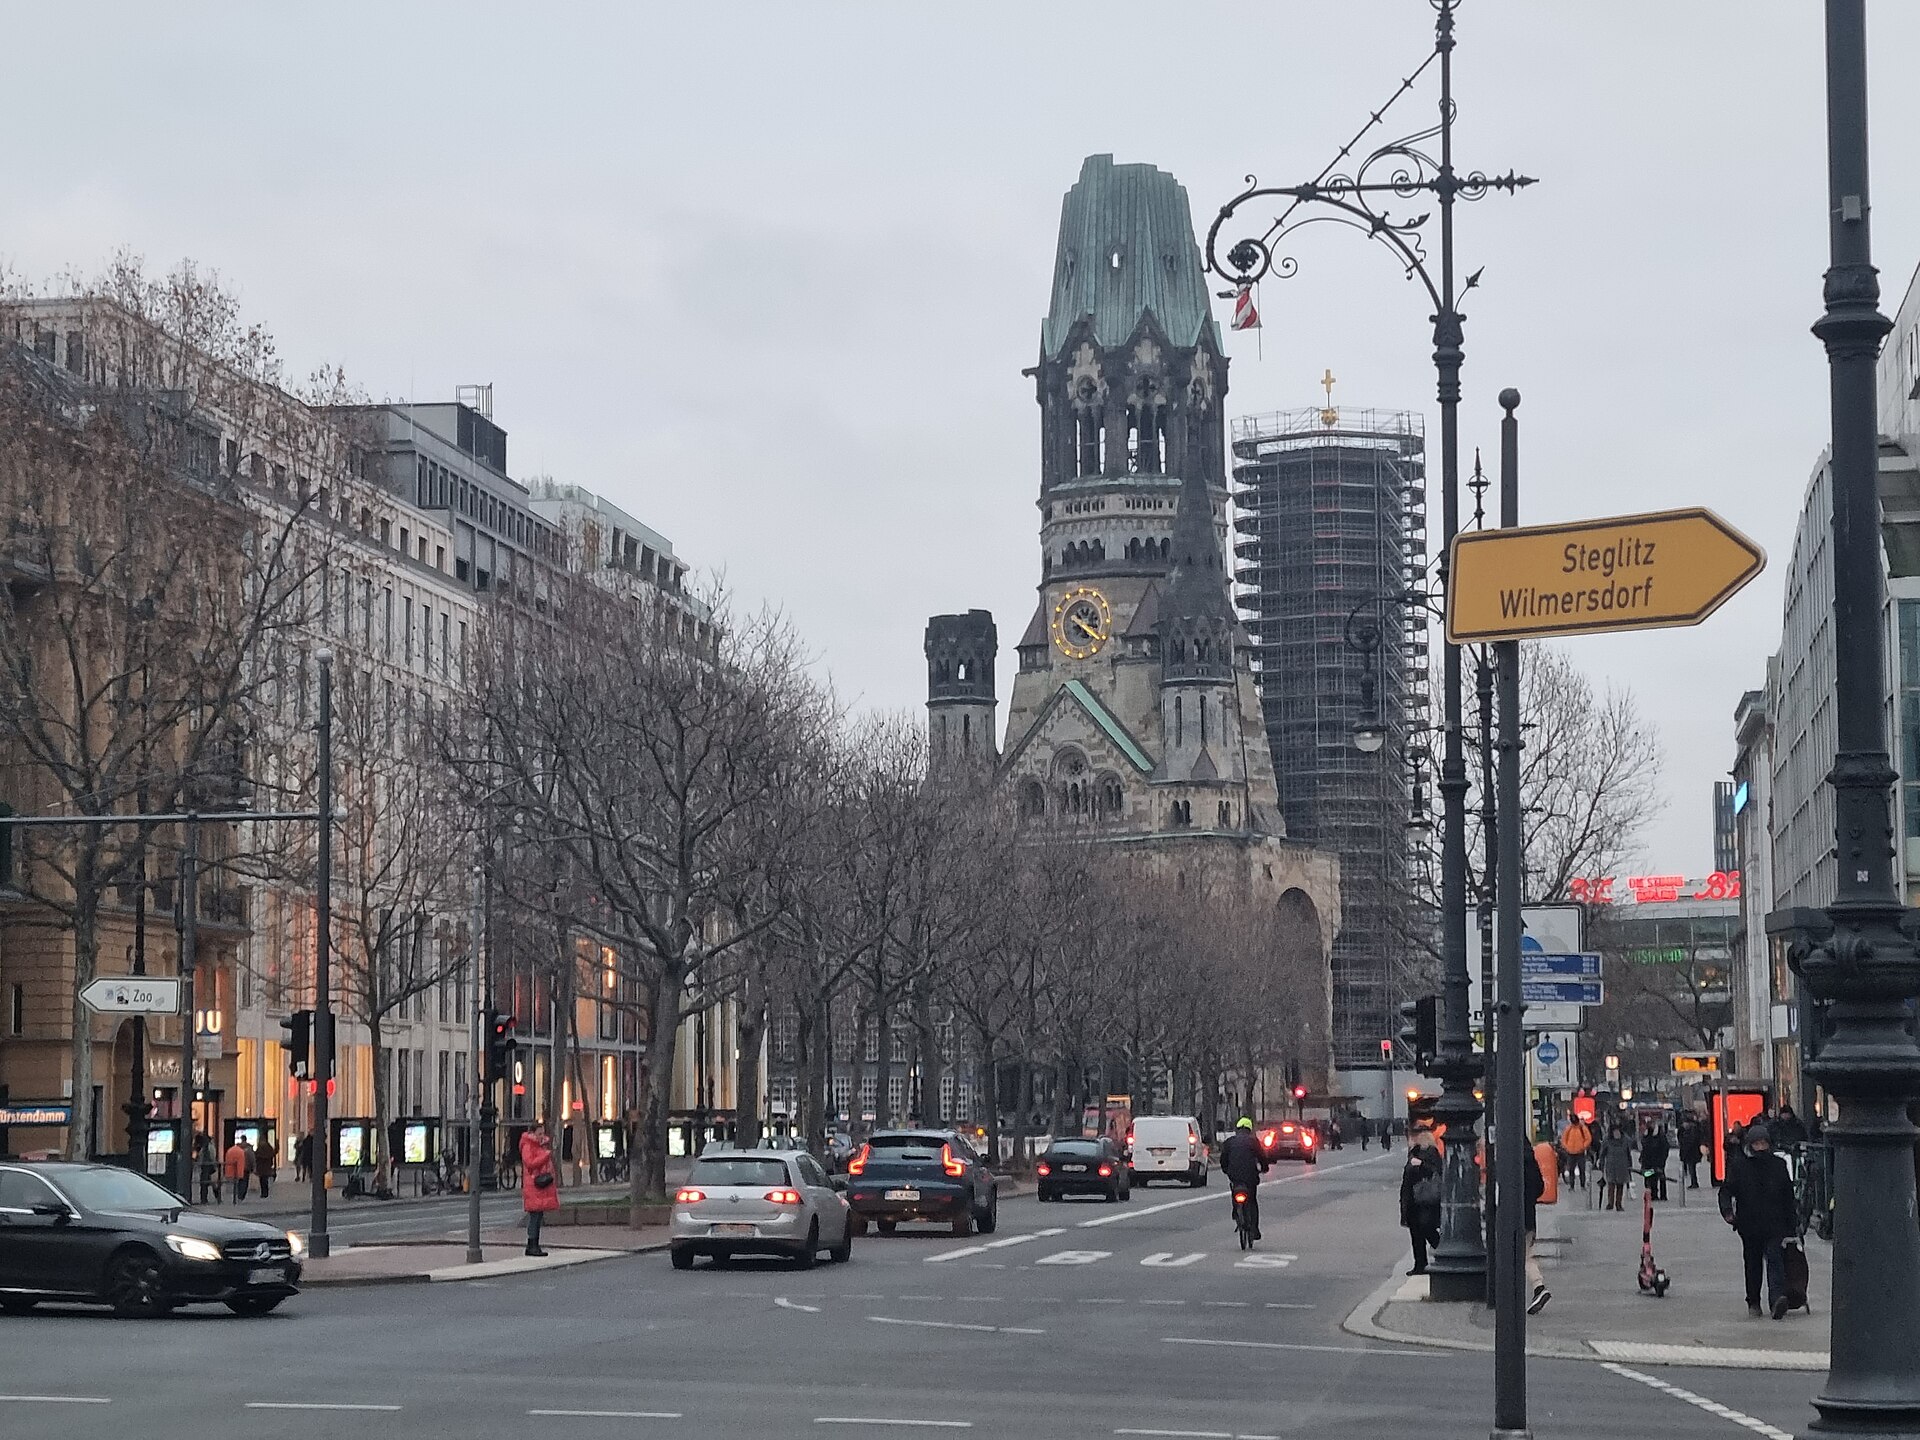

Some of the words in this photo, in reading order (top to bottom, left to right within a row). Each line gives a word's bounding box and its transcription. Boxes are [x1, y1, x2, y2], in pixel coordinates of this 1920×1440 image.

[1562, 537, 1656, 577] Steglitz
[1500, 576, 1653, 619] Wilmersdorf
[133, 989, 153, 1003] Zoo
[206, 1010, 222, 1034] U
[1790, 1007, 1798, 1033] U
[0, 1109, 66, 1123] ürstendamm
[1034, 1250, 1298, 1269] BUS
